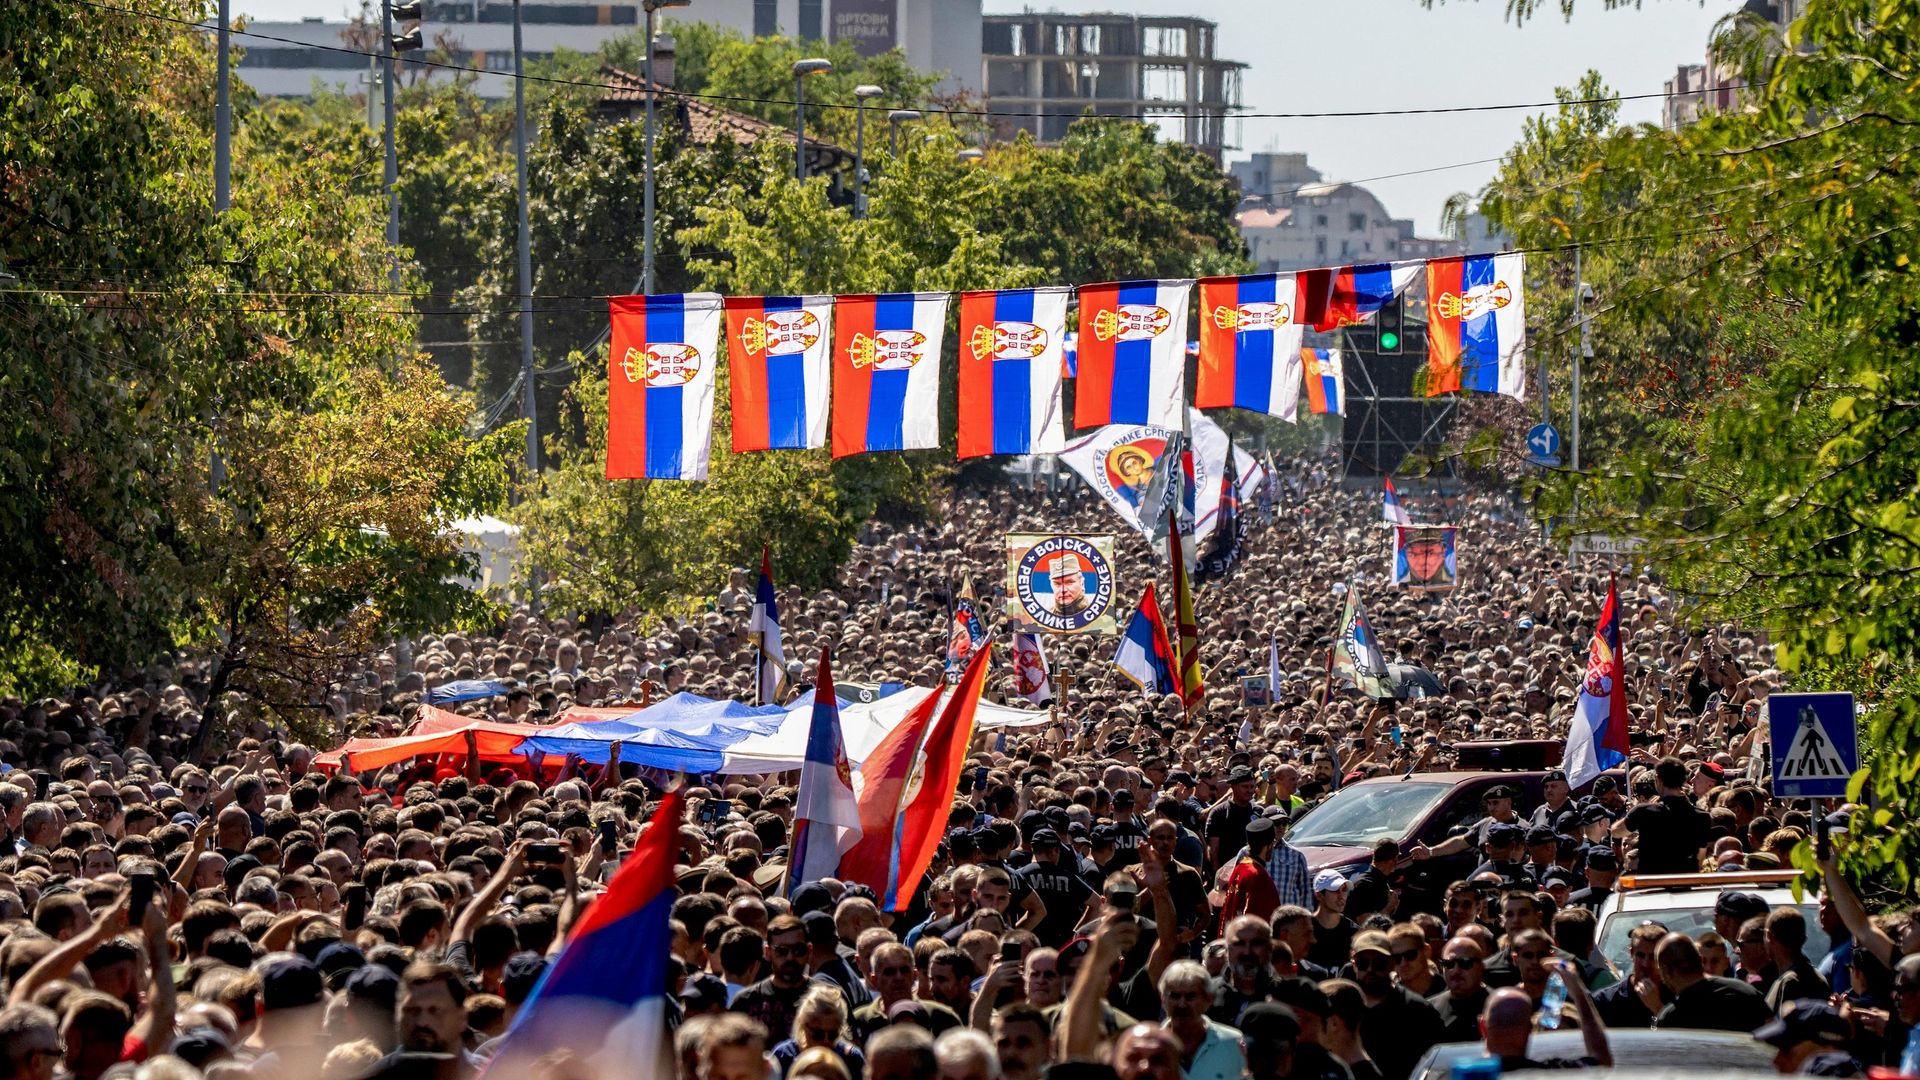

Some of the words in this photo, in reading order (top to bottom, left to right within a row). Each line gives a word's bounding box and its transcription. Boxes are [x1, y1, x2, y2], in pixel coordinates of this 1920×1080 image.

[1144, 428, 1170, 438] СРПС
[1034, 538, 1093, 558] ВОЈСКА
[1017, 564, 1076, 630] РЕПУБЛИКЕ
[1083, 563, 1111, 621] СРПСКЕ
[1029, 873, 1069, 893] ИЈП
